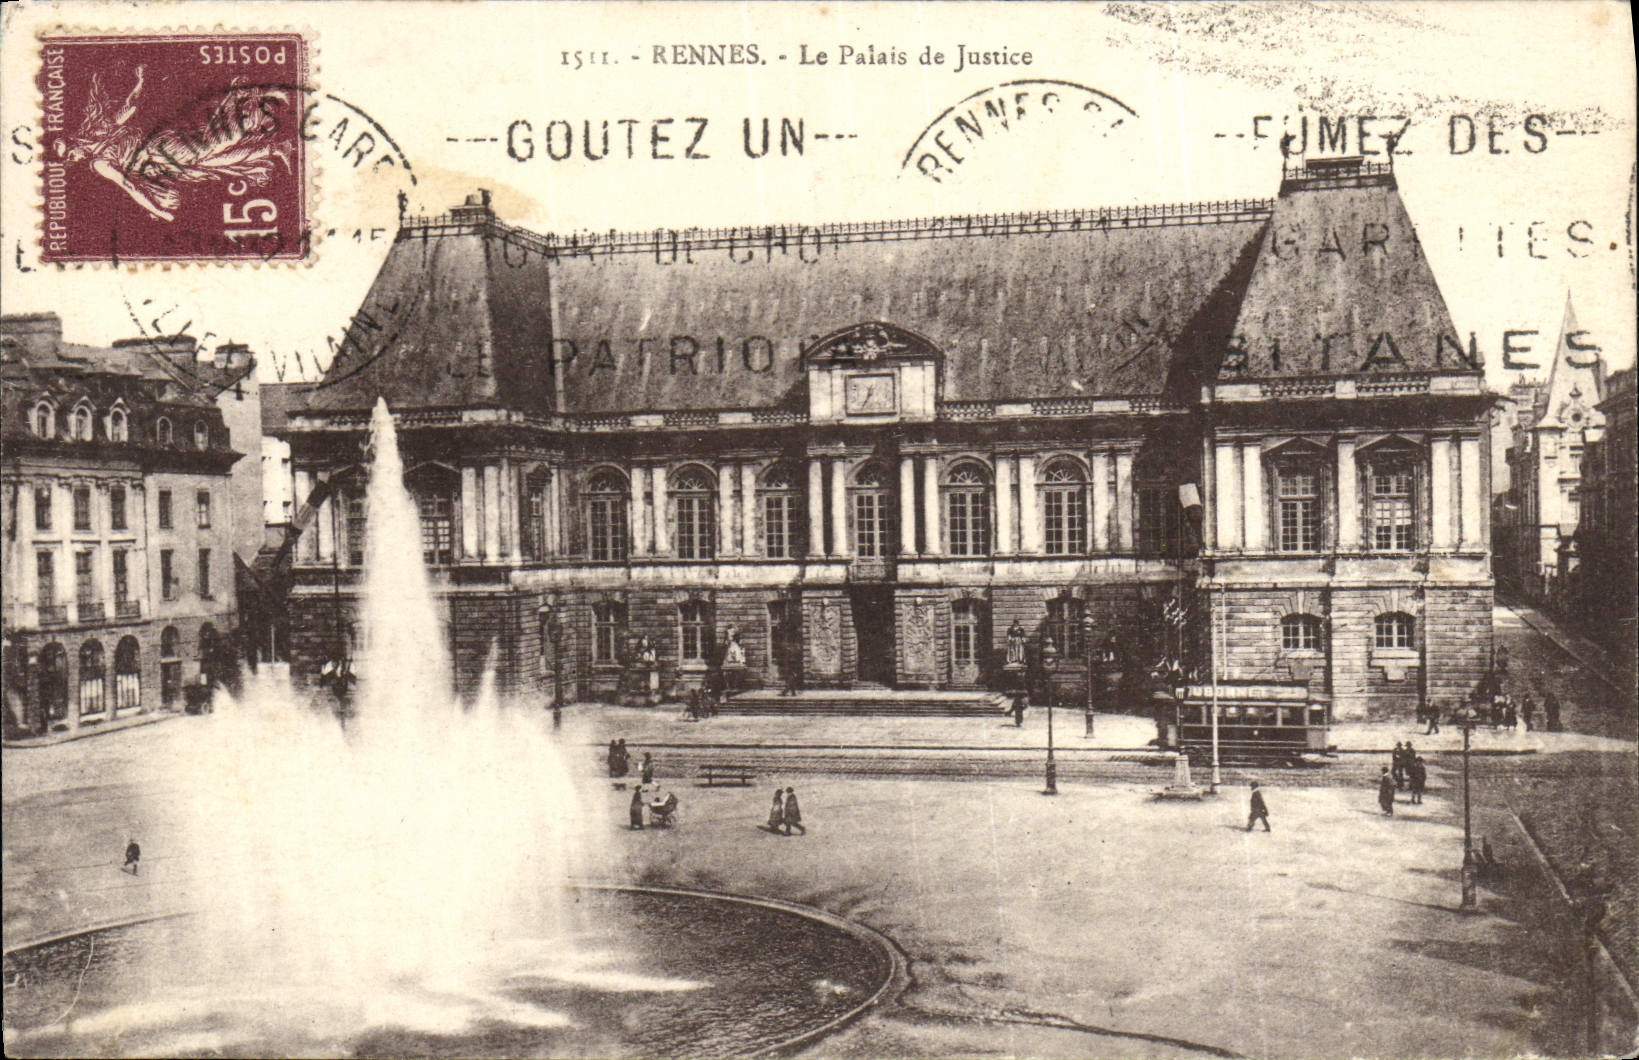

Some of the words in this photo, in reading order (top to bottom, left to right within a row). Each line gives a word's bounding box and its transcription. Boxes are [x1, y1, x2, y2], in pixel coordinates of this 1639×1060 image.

[200, 44, 287, 65] POSTES
[507, 117, 711, 163] GOUTEZ
[743, 117, 805, 159] UN
[1253, 114, 1414, 157] FUMEZ
[1448, 113, 1549, 155] DES
